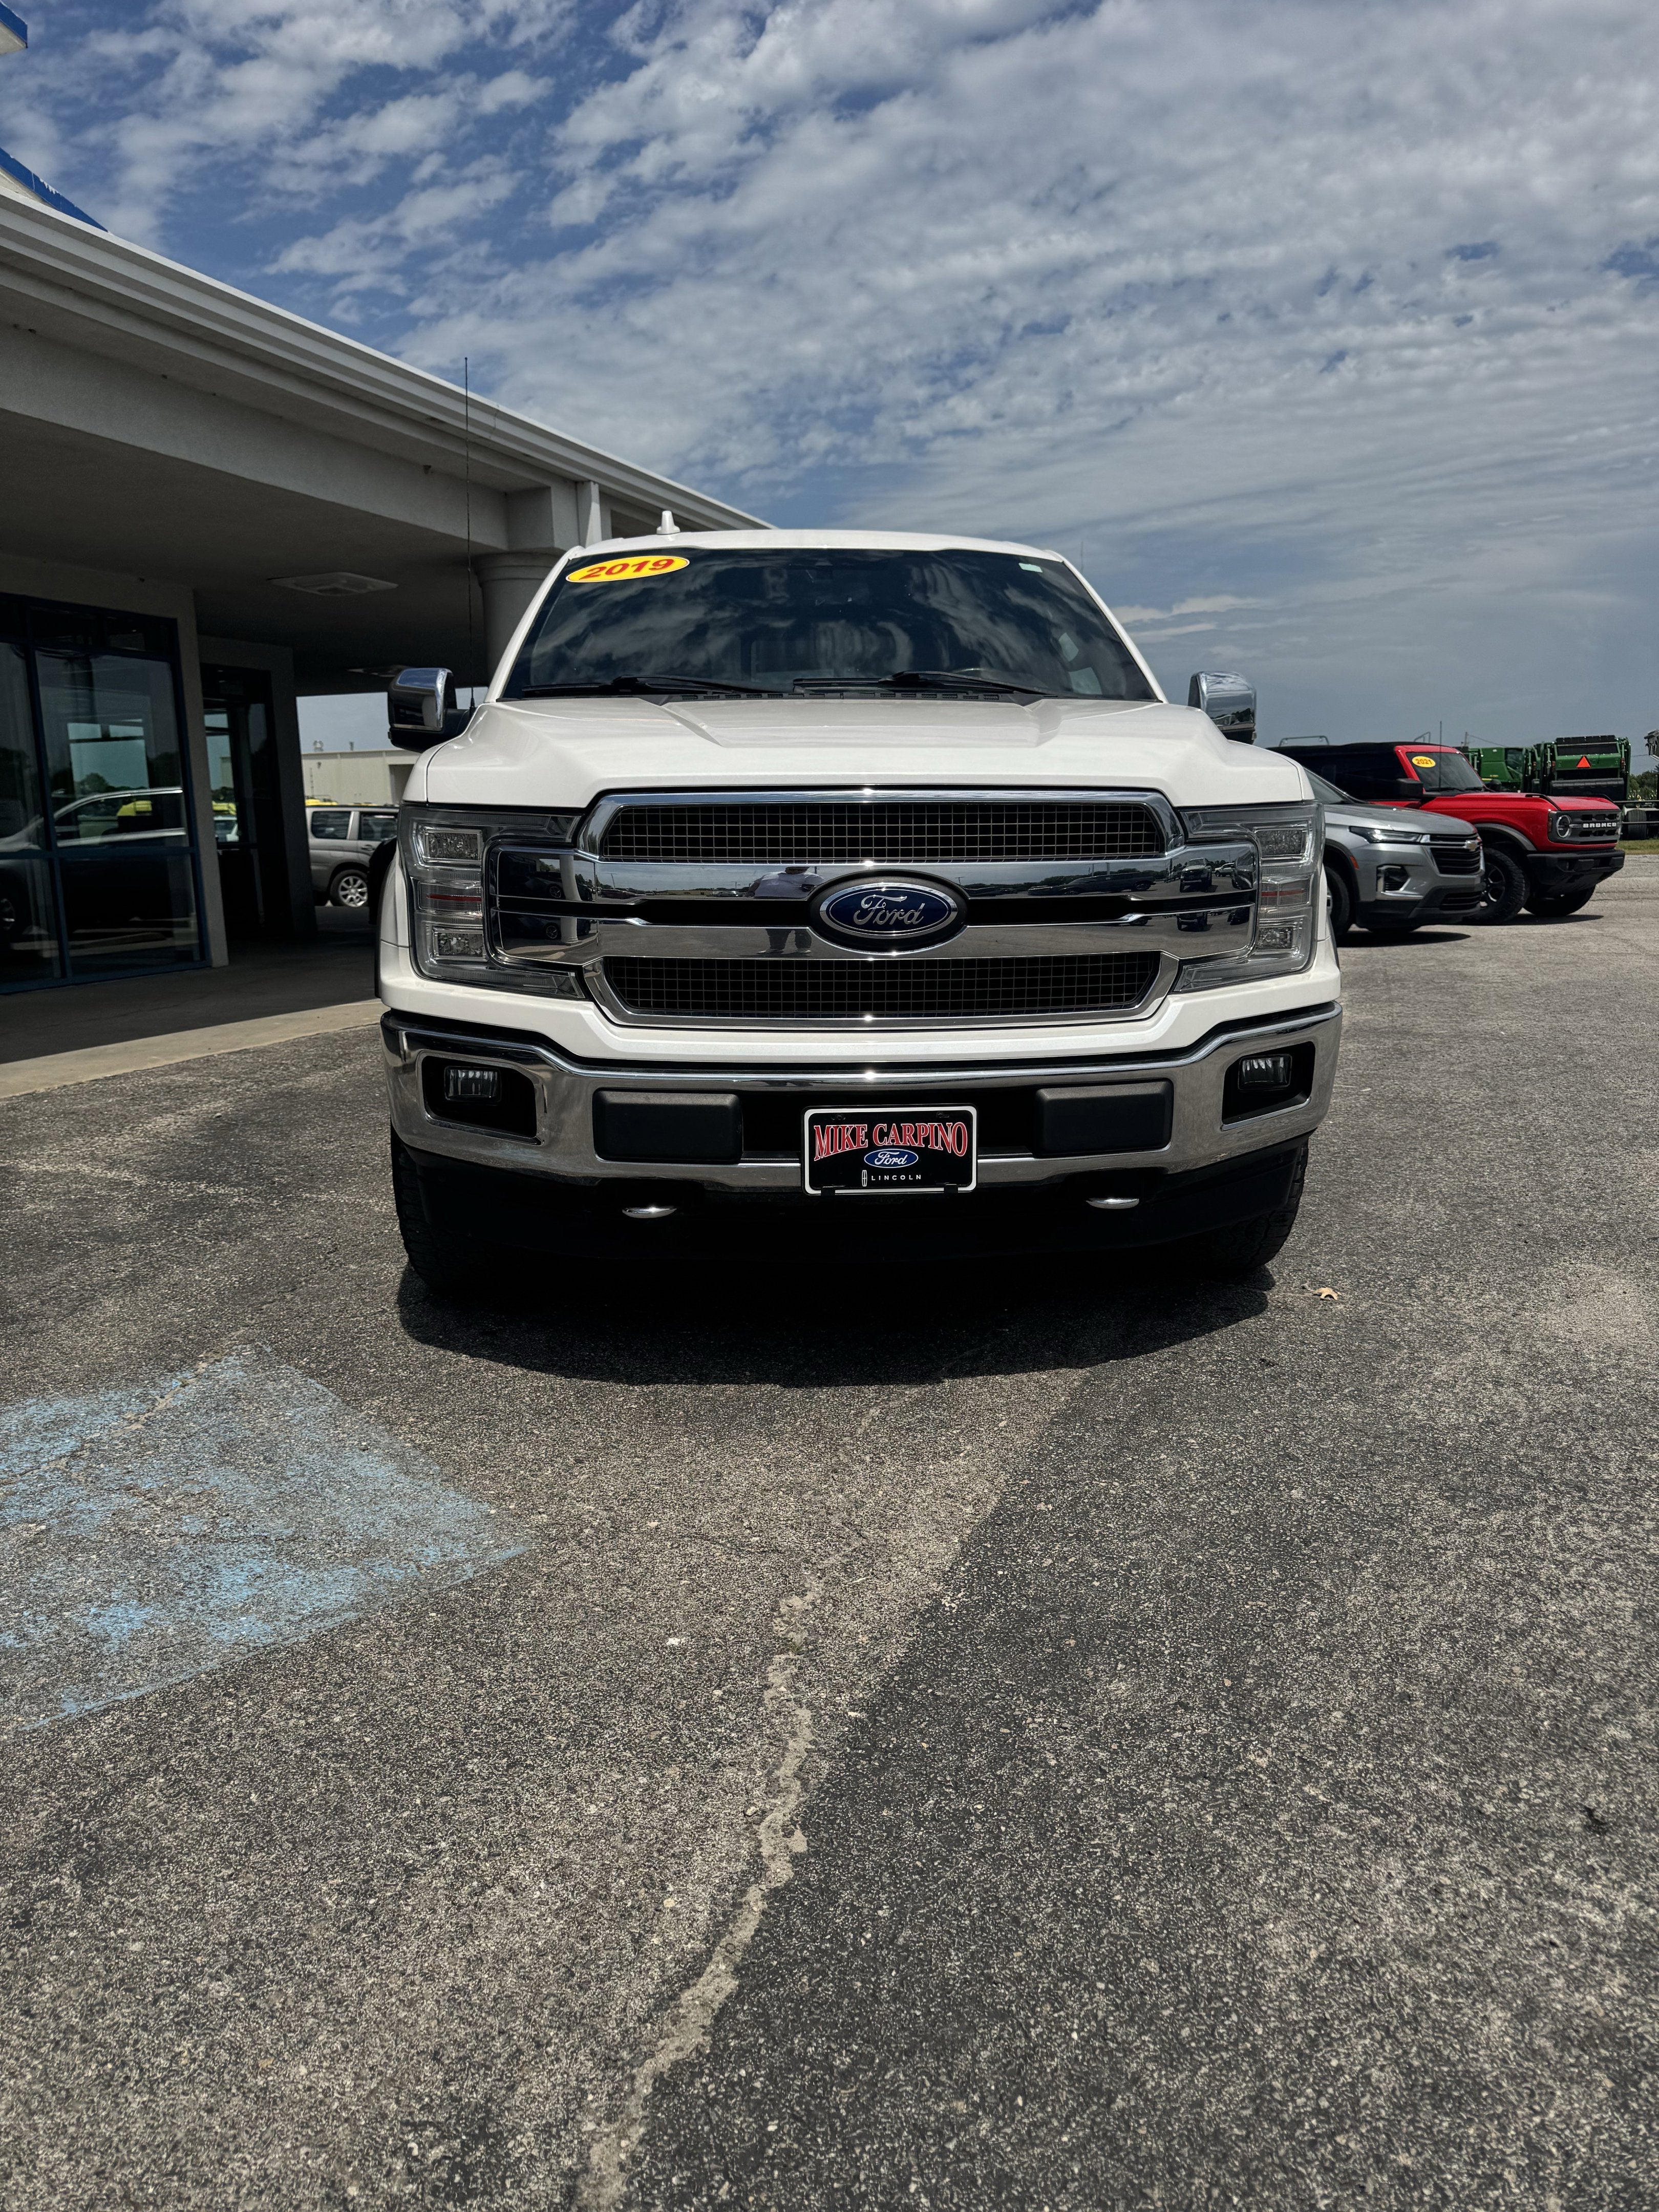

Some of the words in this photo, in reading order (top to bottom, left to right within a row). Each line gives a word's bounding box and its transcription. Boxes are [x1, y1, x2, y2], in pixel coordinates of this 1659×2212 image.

[579, 559, 674, 580] 2019
[853, 894, 925, 925] Ford
[814, 1124, 868, 1161] MIKE
[873, 1122, 968, 1157] CARPINO
[874, 1151, 908, 1165] Ford
